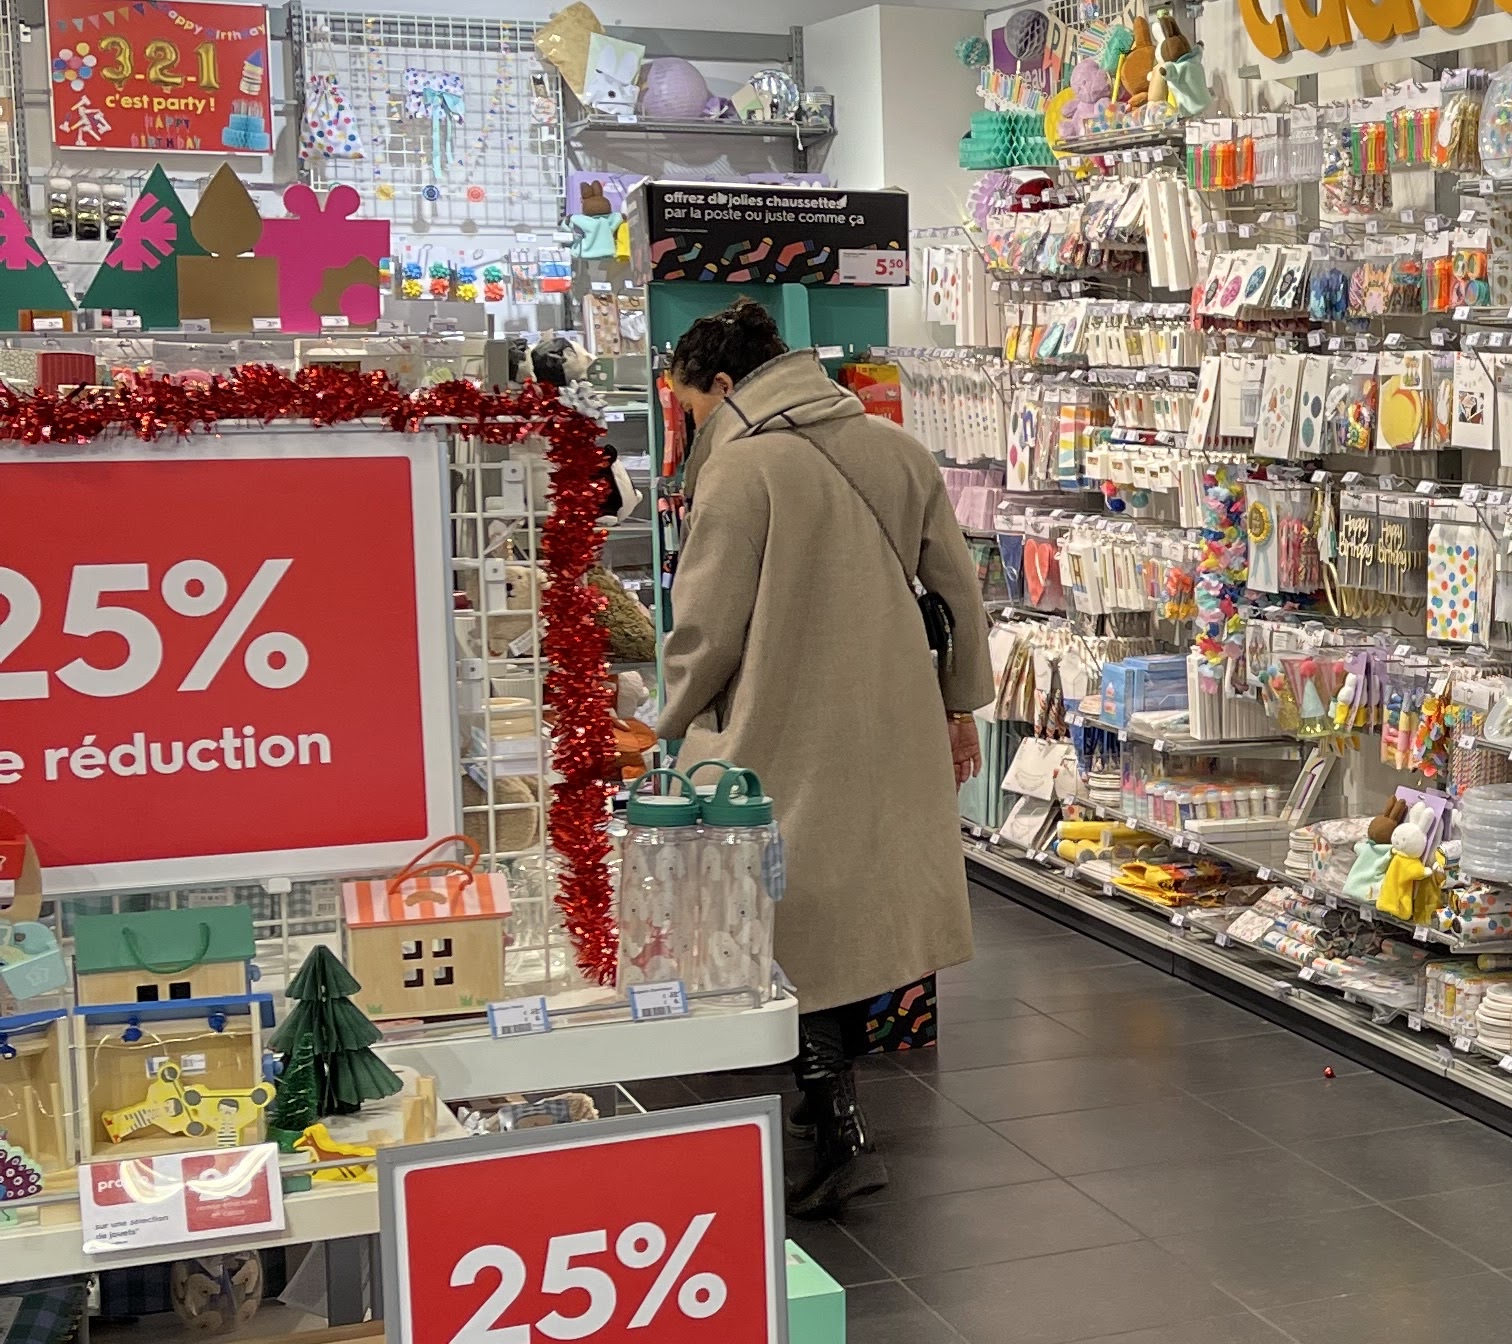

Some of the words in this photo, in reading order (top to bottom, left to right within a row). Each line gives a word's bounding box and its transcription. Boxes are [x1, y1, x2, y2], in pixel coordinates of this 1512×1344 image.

[105, 93, 149, 109] c'est
[152, 96, 206, 114] party
[664, 192, 705, 205] offrez
[665, 208, 689, 221] par
[690, 208, 702, 219] la
[704, 210, 742, 223] poste
[745, 211, 762, 221] ou
[764, 210, 796, 224] juste
[799, 213, 846, 224] comme
[849, 214, 865, 226] ça
[44, 725, 332, 782] réduction
